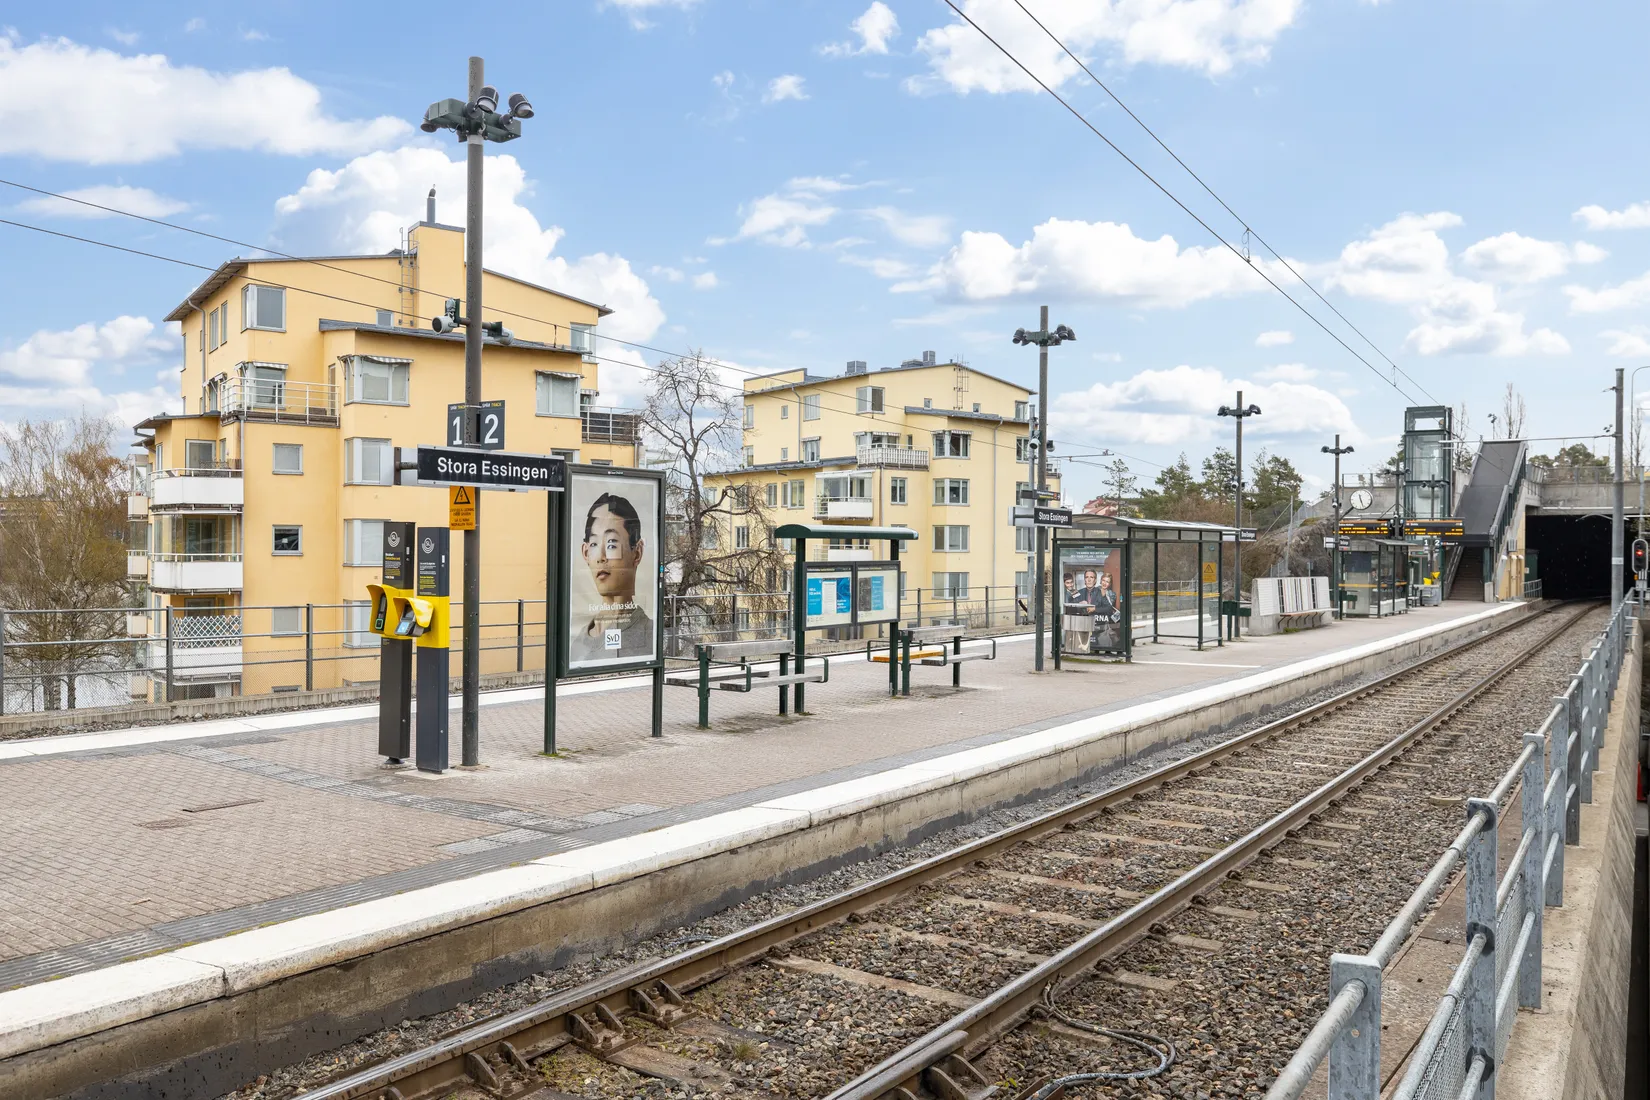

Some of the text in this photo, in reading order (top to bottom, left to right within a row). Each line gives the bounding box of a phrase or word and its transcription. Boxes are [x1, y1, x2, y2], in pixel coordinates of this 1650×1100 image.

[452, 416, 462, 445] 1
[484, 413, 498, 444] 2
[437, 457, 548, 481] Stora Essingen
[1038, 511, 1069, 523] Stora Essingen
[606, 634, 620, 643] SvD
